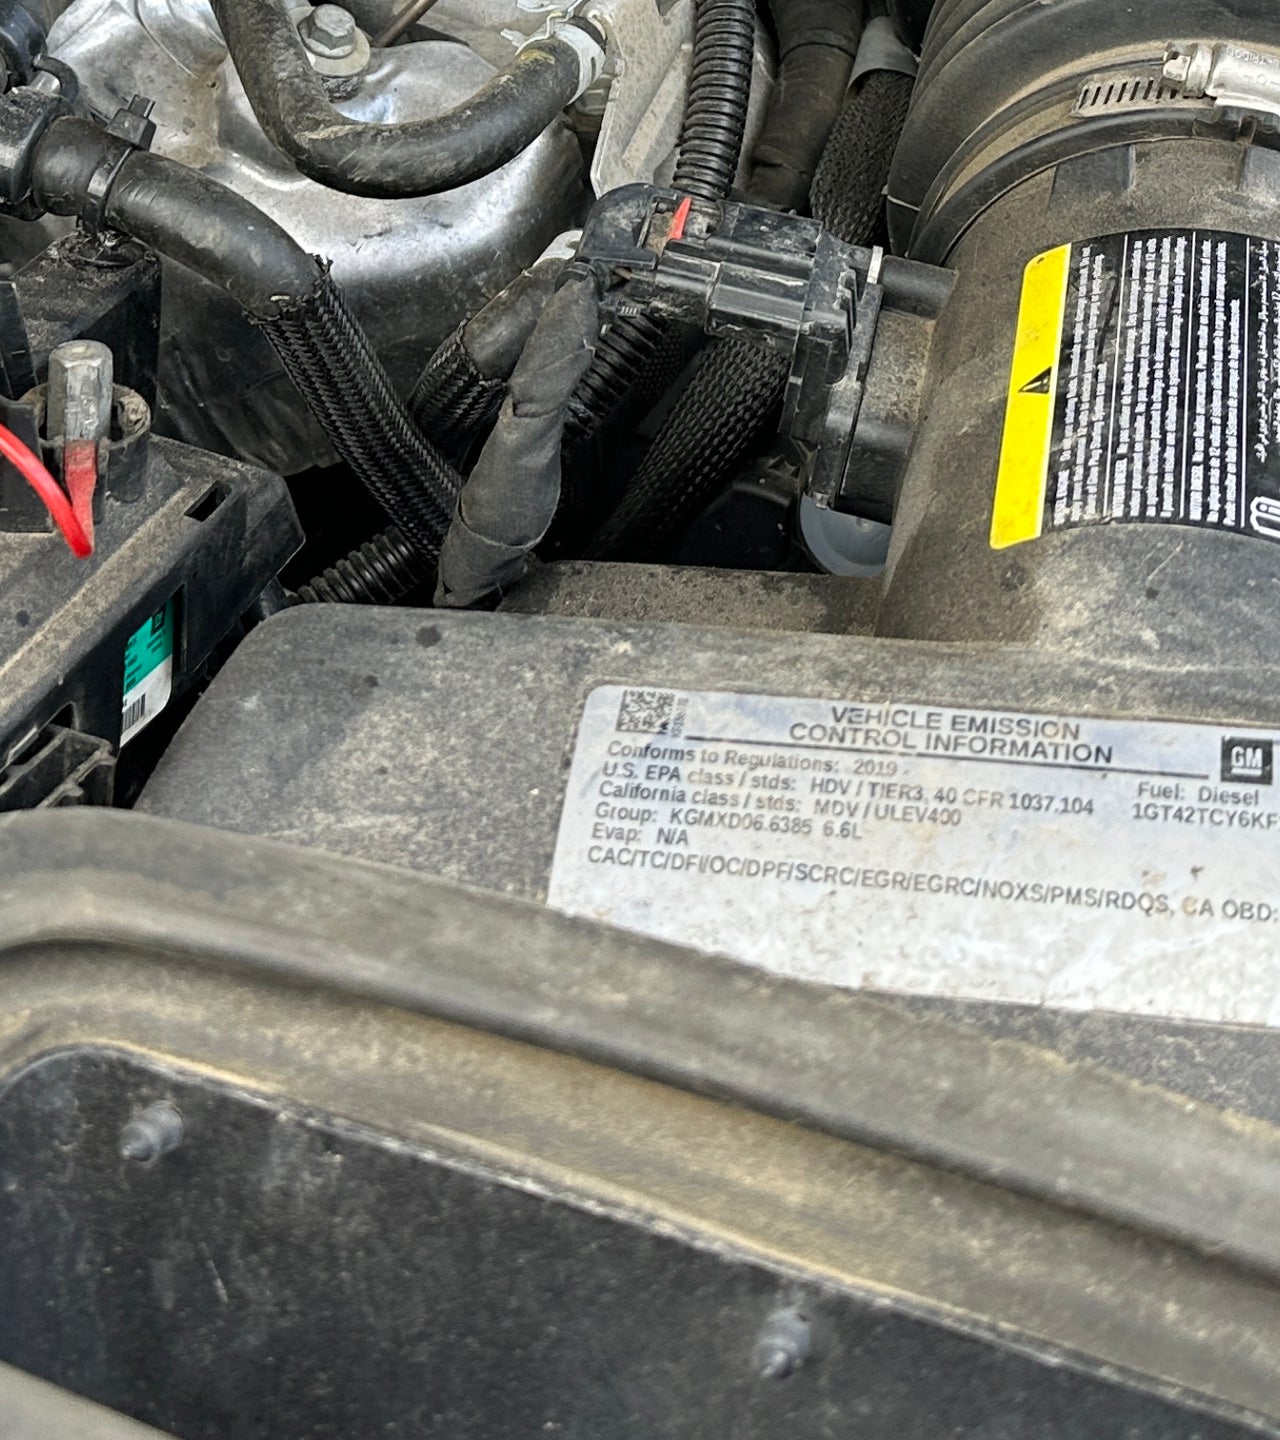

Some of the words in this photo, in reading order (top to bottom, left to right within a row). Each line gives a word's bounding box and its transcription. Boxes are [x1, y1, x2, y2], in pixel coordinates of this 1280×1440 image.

[832, 706, 943, 729] VEHICLE
[951, 715, 1080, 740] EMISSION
[607, 741, 695, 761] Conforms
[701, 747, 719, 763] to
[724, 750, 839, 775] Regulations:
[853, 758, 898, 777] 2019
[789, 722, 917, 750] CONTROL
[925, 733, 1112, 765] INFORMATION
[1230, 745, 1263, 769] GM
[599, 781, 686, 804] California
[691, 788, 740, 808] class
[755, 792, 802, 812] stds:
[814, 798, 859, 818] MDV
[602, 762, 638, 779] U.S.
[645, 764, 681, 783] EPA
[687, 767, 734, 787] class
[751, 771, 797, 790] stds:
[810, 776, 852, 796] HDV
[932, 786, 957, 805] 40
[962, 788, 1003, 808] CFR
[1009, 792, 1095, 815] 1037.104
[1137, 781, 1185, 800] Fuel:
[1198, 786, 1260, 806] Diesel
[592, 822, 642, 845] Evap:
[656, 827, 689, 846] N/A
[595, 801, 658, 825] Group:
[670, 808, 812, 836] KGMXD06.6385
[823, 820, 863, 840] 6.6L
[1182, 897, 1215, 918] CA
[1221, 900, 1278, 923] OBD:
